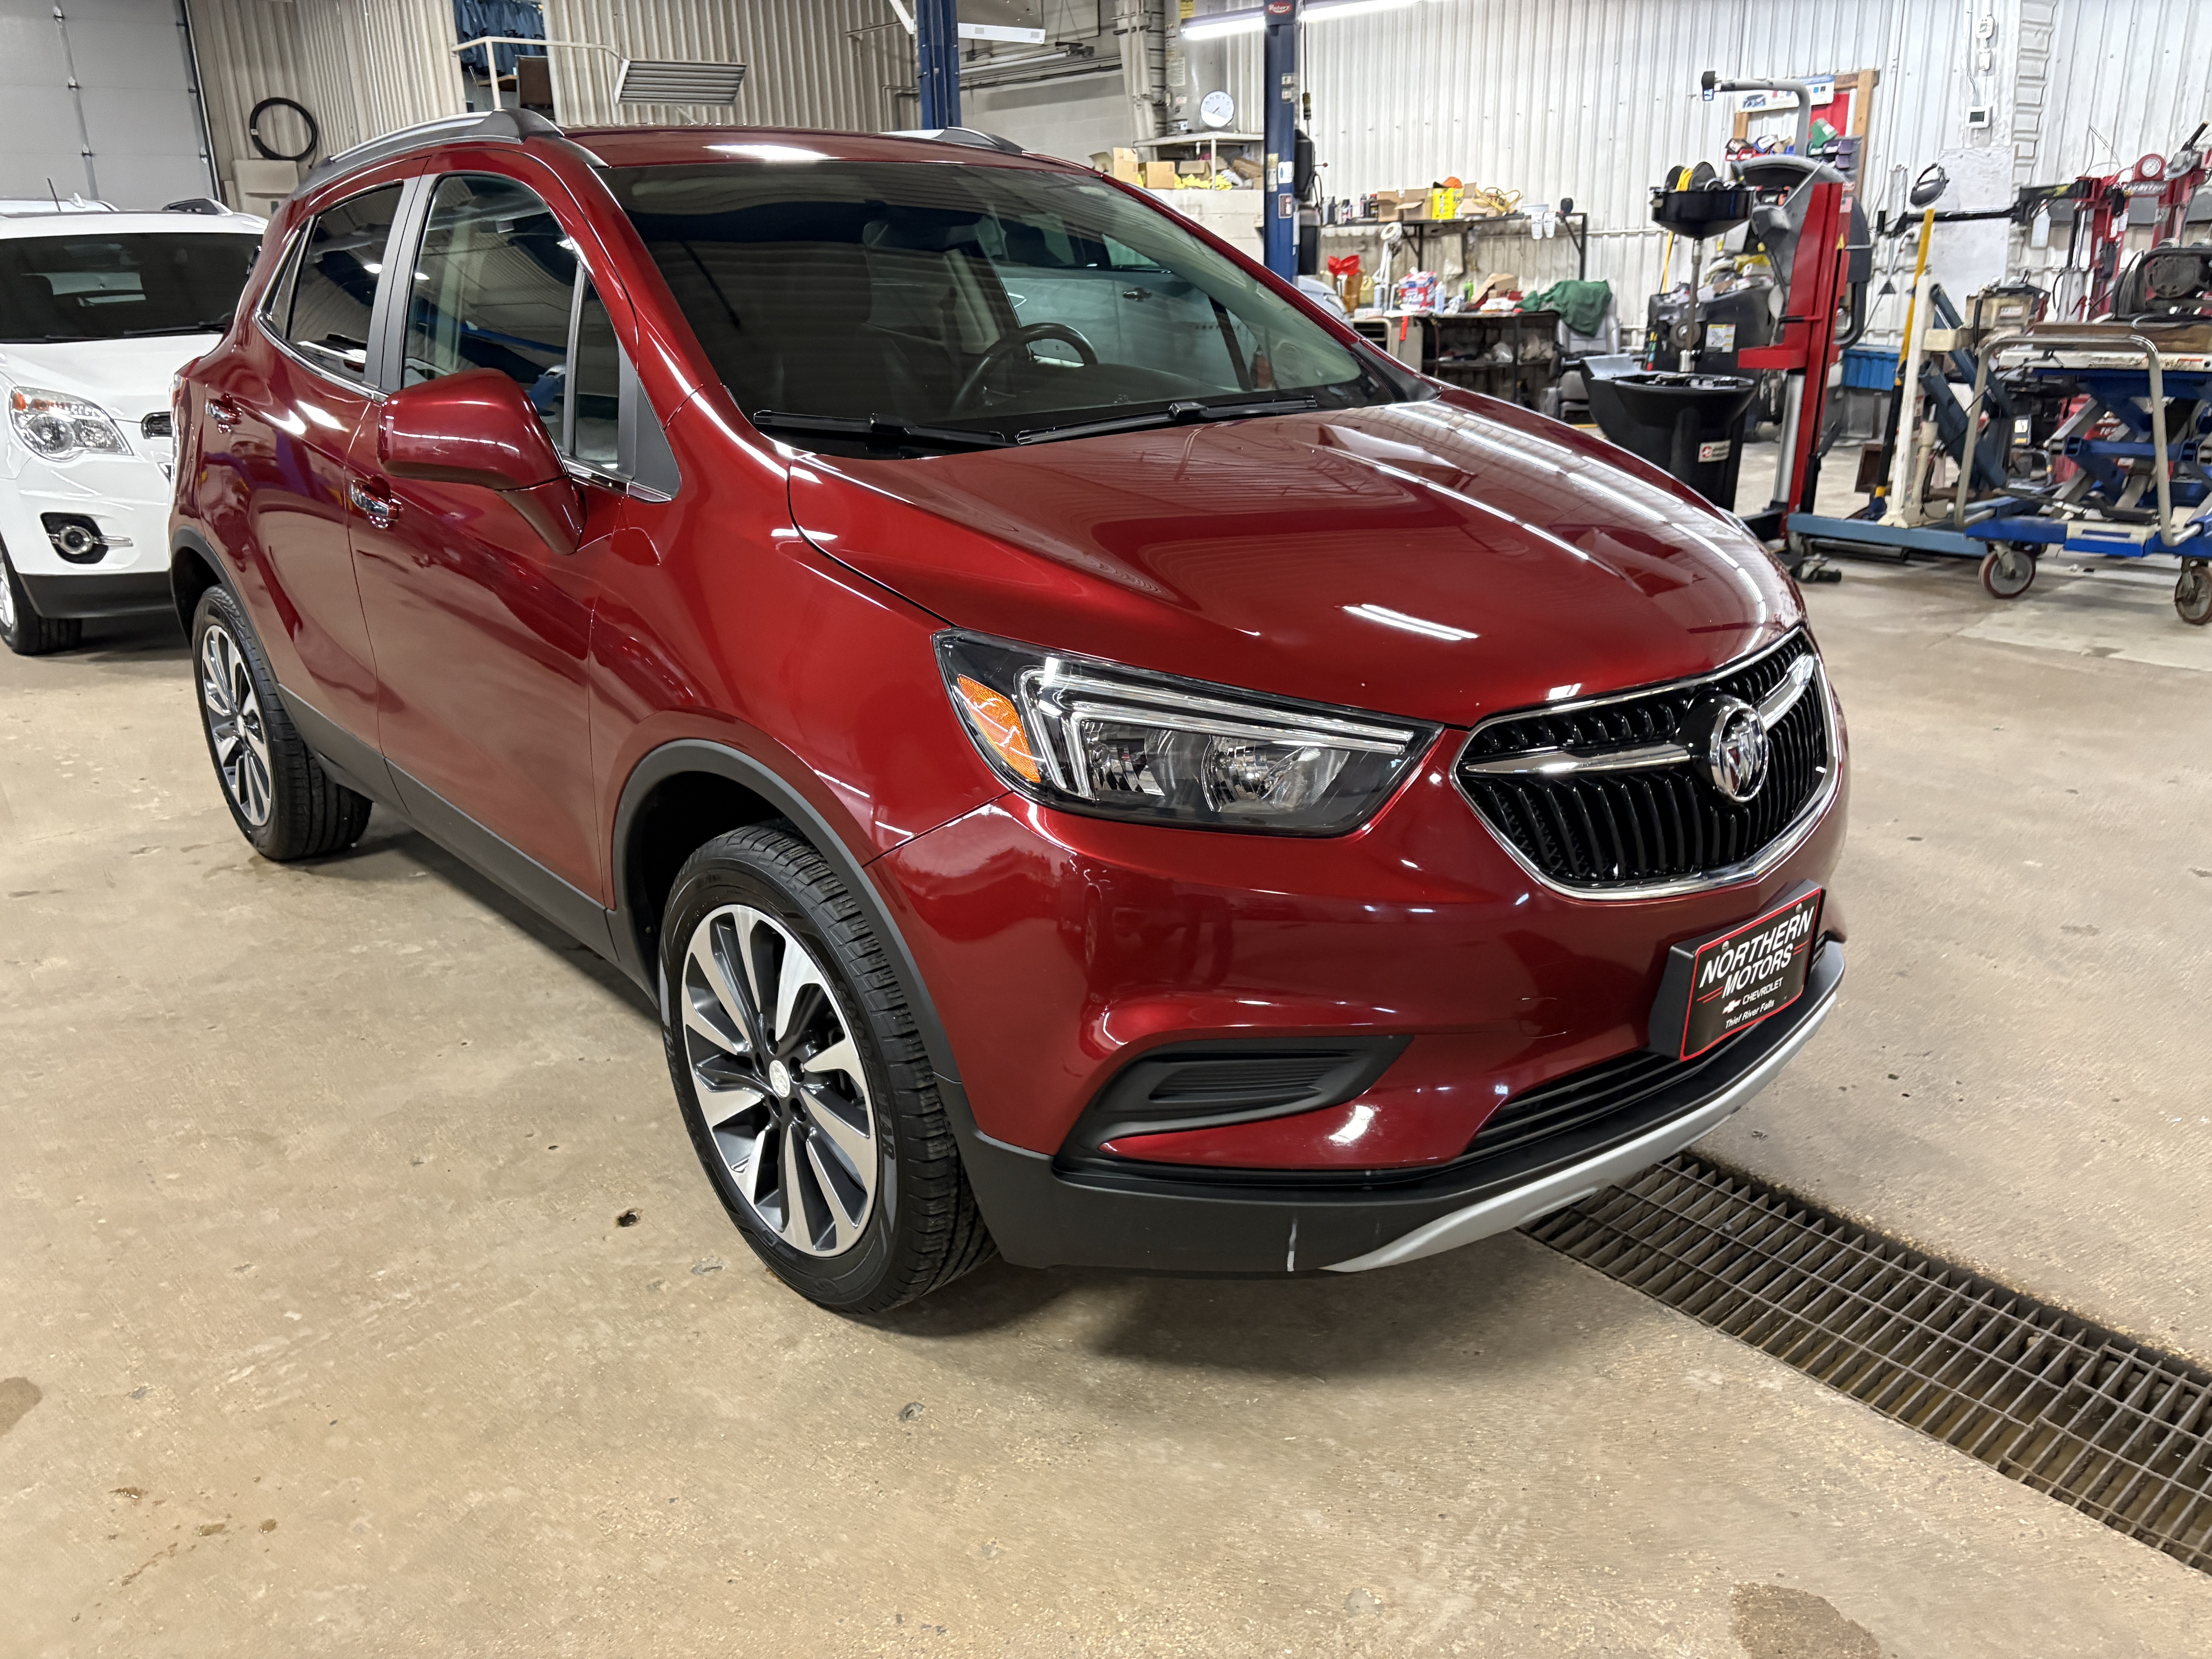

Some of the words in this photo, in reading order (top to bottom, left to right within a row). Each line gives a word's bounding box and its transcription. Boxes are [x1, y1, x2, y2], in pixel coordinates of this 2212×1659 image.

[1699, 906, 1815, 988] NORTHERN
[1722, 943, 1793, 999] MOTORS
[1743, 977, 1784, 1005] CHEVROLET
[1726, 1013, 1743, 1029] Thief
[1742, 1007, 1760, 1021] River
[1759, 999, 1775, 1012] Falls
